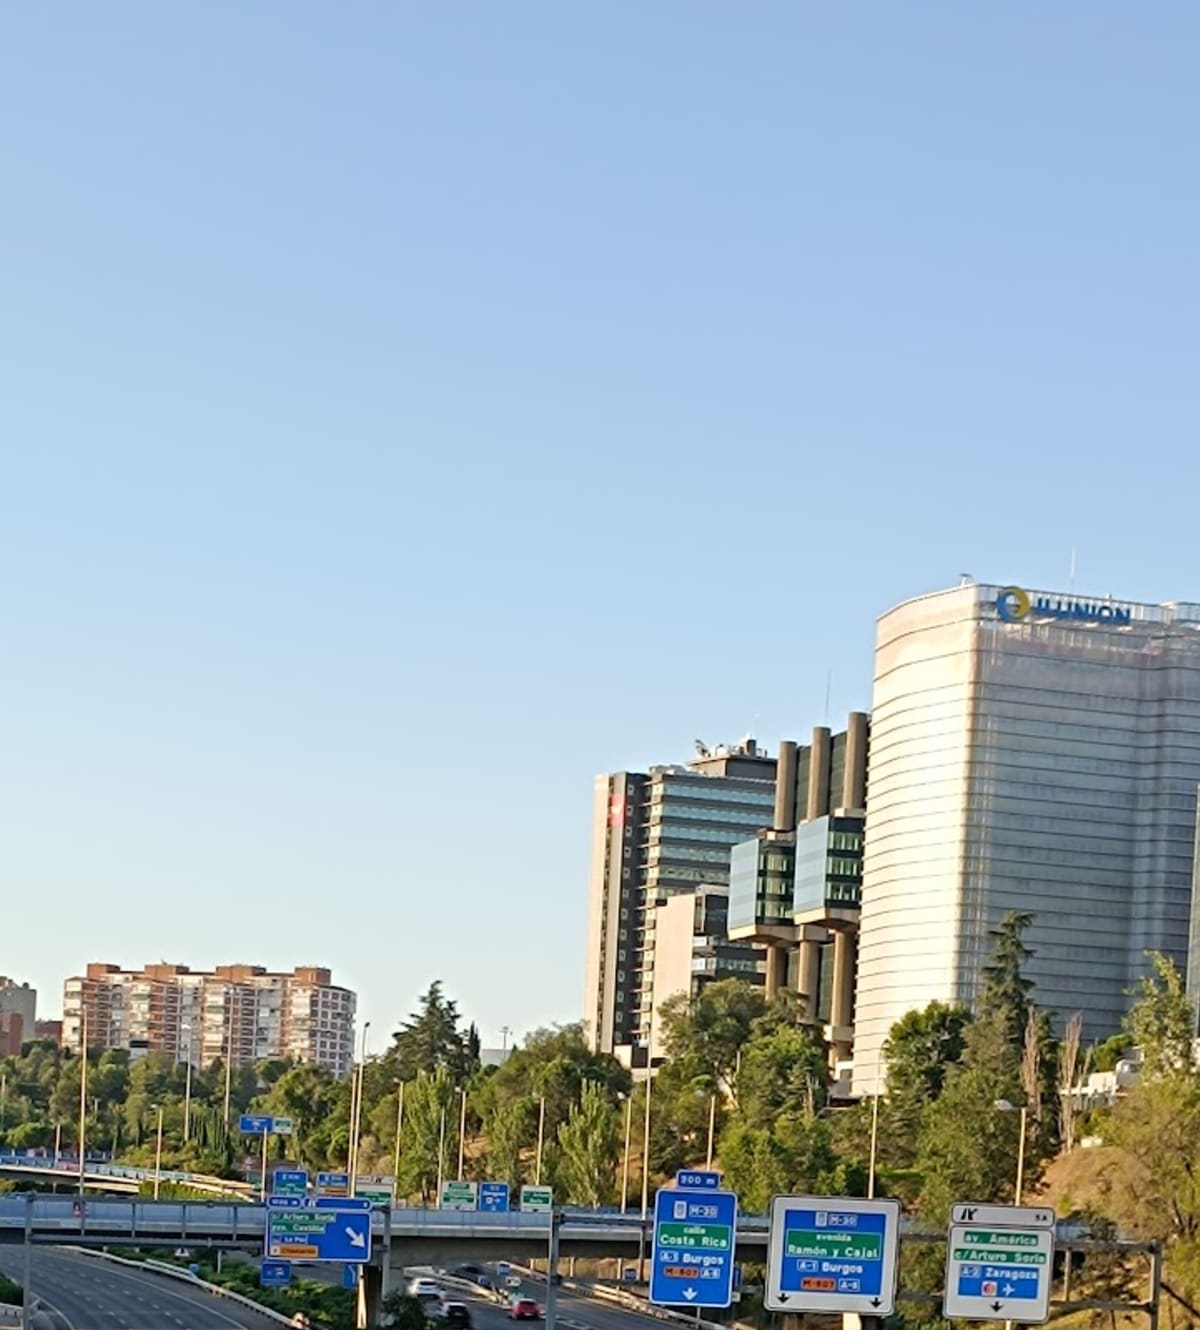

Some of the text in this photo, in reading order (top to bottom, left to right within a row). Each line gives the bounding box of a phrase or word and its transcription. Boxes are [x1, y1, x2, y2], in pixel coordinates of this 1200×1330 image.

[684, 1226, 705, 1234] calle
[661, 1234, 727, 1247] Costa Rica
[816, 1233, 851, 1242] avenida
[990, 1235, 1037, 1244] América
[788, 1244, 878, 1258] Ramón y Cajal
[955, 1250, 1045, 1263] c/Arturo Soria
[682, 1253, 724, 1265] Burgos
[800, 1261, 863, 1275] A-1 Burgos
[985, 1267, 1038, 1280] Zaragoza
